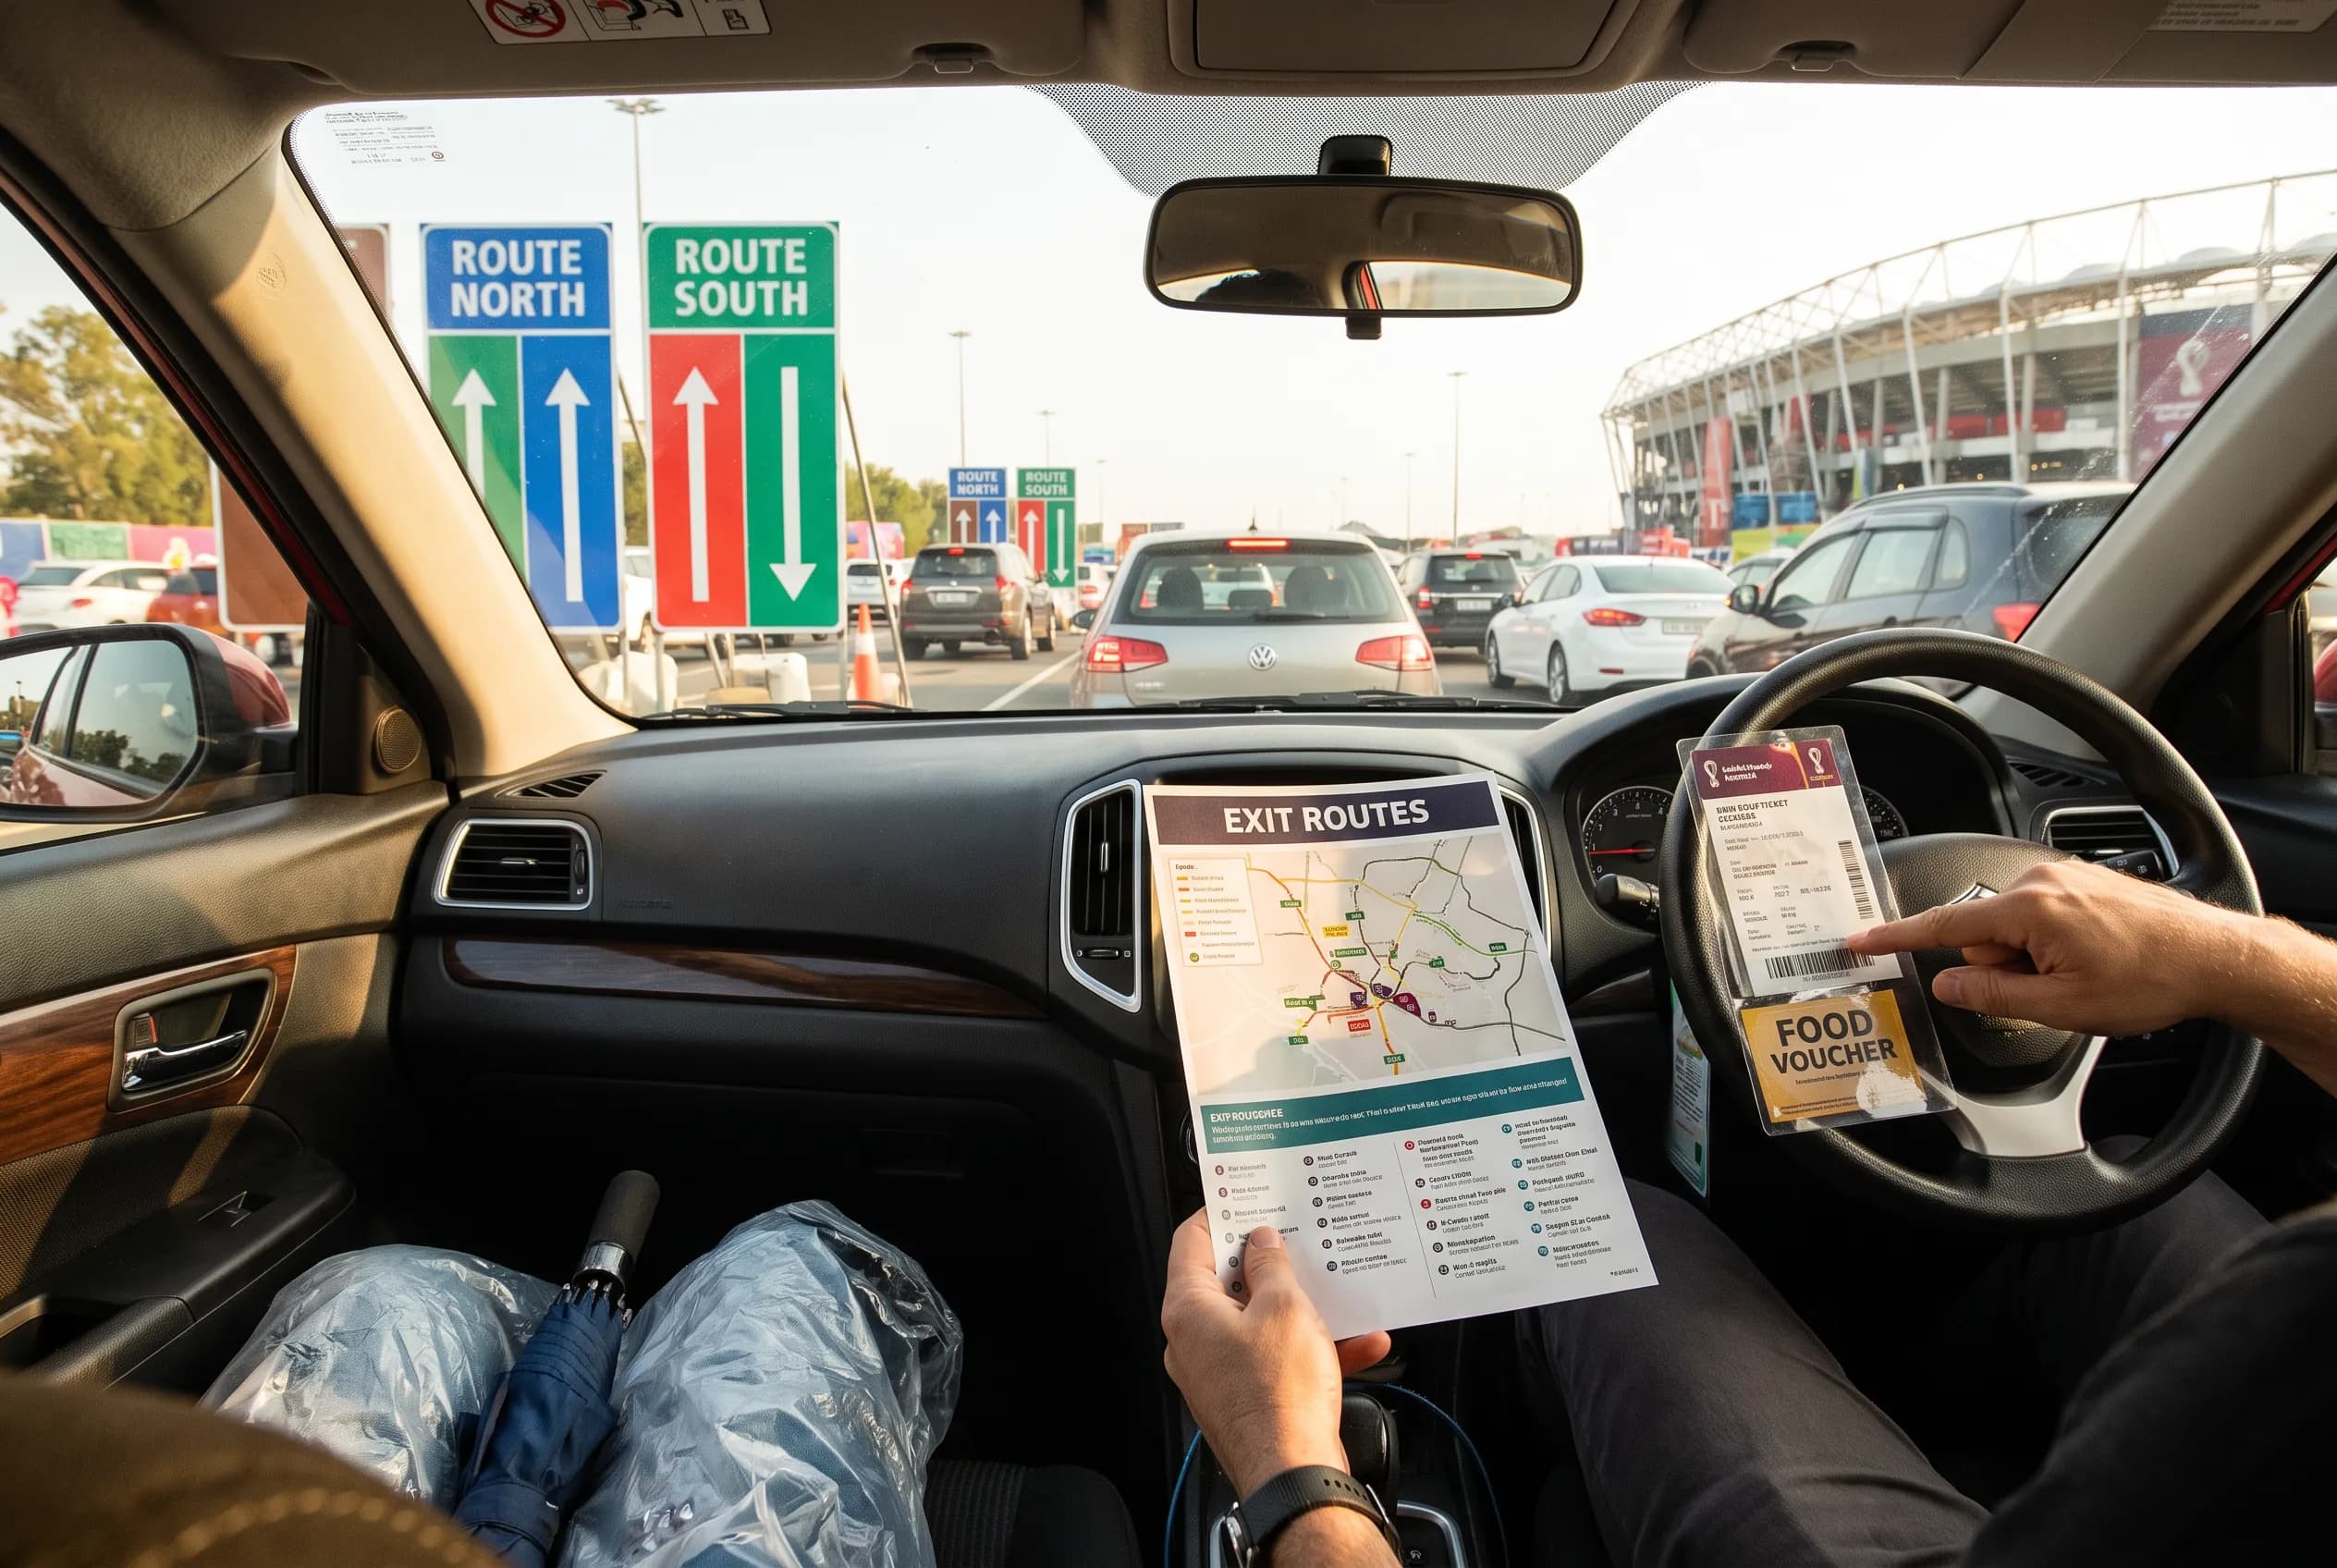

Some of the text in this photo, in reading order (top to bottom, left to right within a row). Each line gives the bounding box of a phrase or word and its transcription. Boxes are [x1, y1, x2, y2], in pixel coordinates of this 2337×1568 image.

[451, 239, 582, 276] ROUTE
[675, 238, 806, 275] ROUTE
[450, 281, 585, 317] NORTH
[674, 280, 808, 316] SOUTH
[957, 471, 998, 483] ROUTE
[957, 484, 998, 495] NORTH
[1025, 471, 1067, 483] ROUTE
[1025, 484, 1068, 495] SOUTH
[1223, 799, 1429, 833] EXIT ROUTES
[1775, 1010, 1873, 1047] FOOD
[1770, 1038, 1898, 1074] VOUCHER
